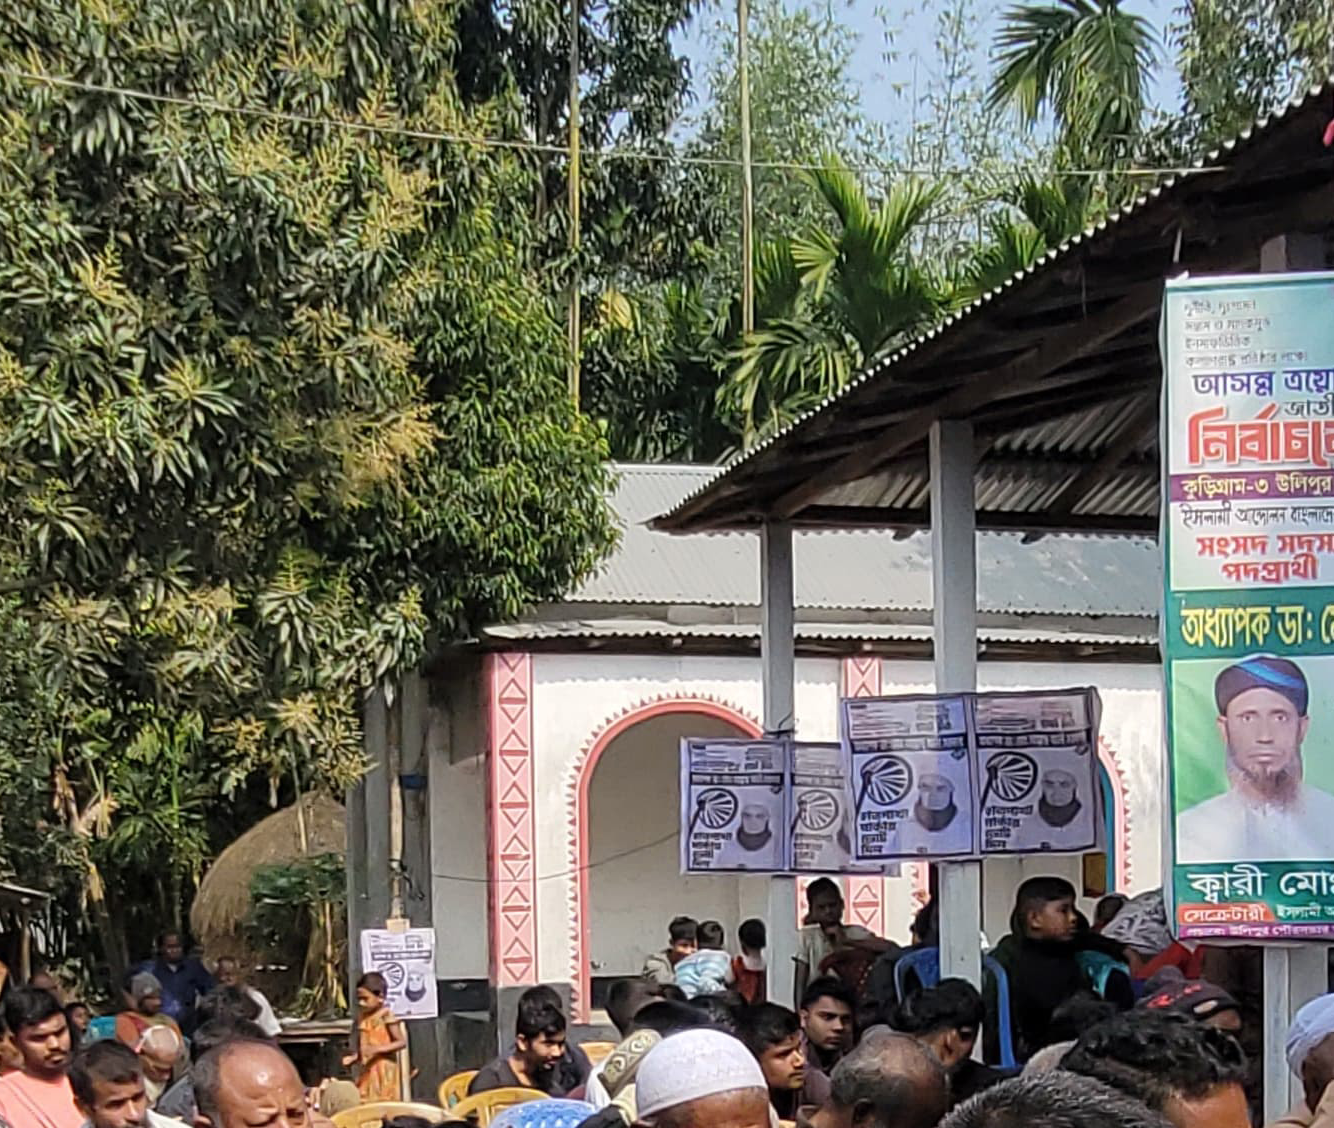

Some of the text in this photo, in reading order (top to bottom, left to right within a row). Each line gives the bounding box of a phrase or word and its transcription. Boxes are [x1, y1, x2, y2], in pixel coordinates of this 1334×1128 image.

[1192, 371, 1275, 397] আসন্ন
[1181, 472, 1269, 500] কুড়িগ্রাম-৩
[1275, 470, 1332, 495] উলিপুর
[1181, 501, 1231, 528] ইসলামী
[1196, 534, 1269, 559] সংসদ
[1181, 601, 1271, 649] অধ্যাপক
[1184, 903, 1265, 922] সেক্রেটারী
